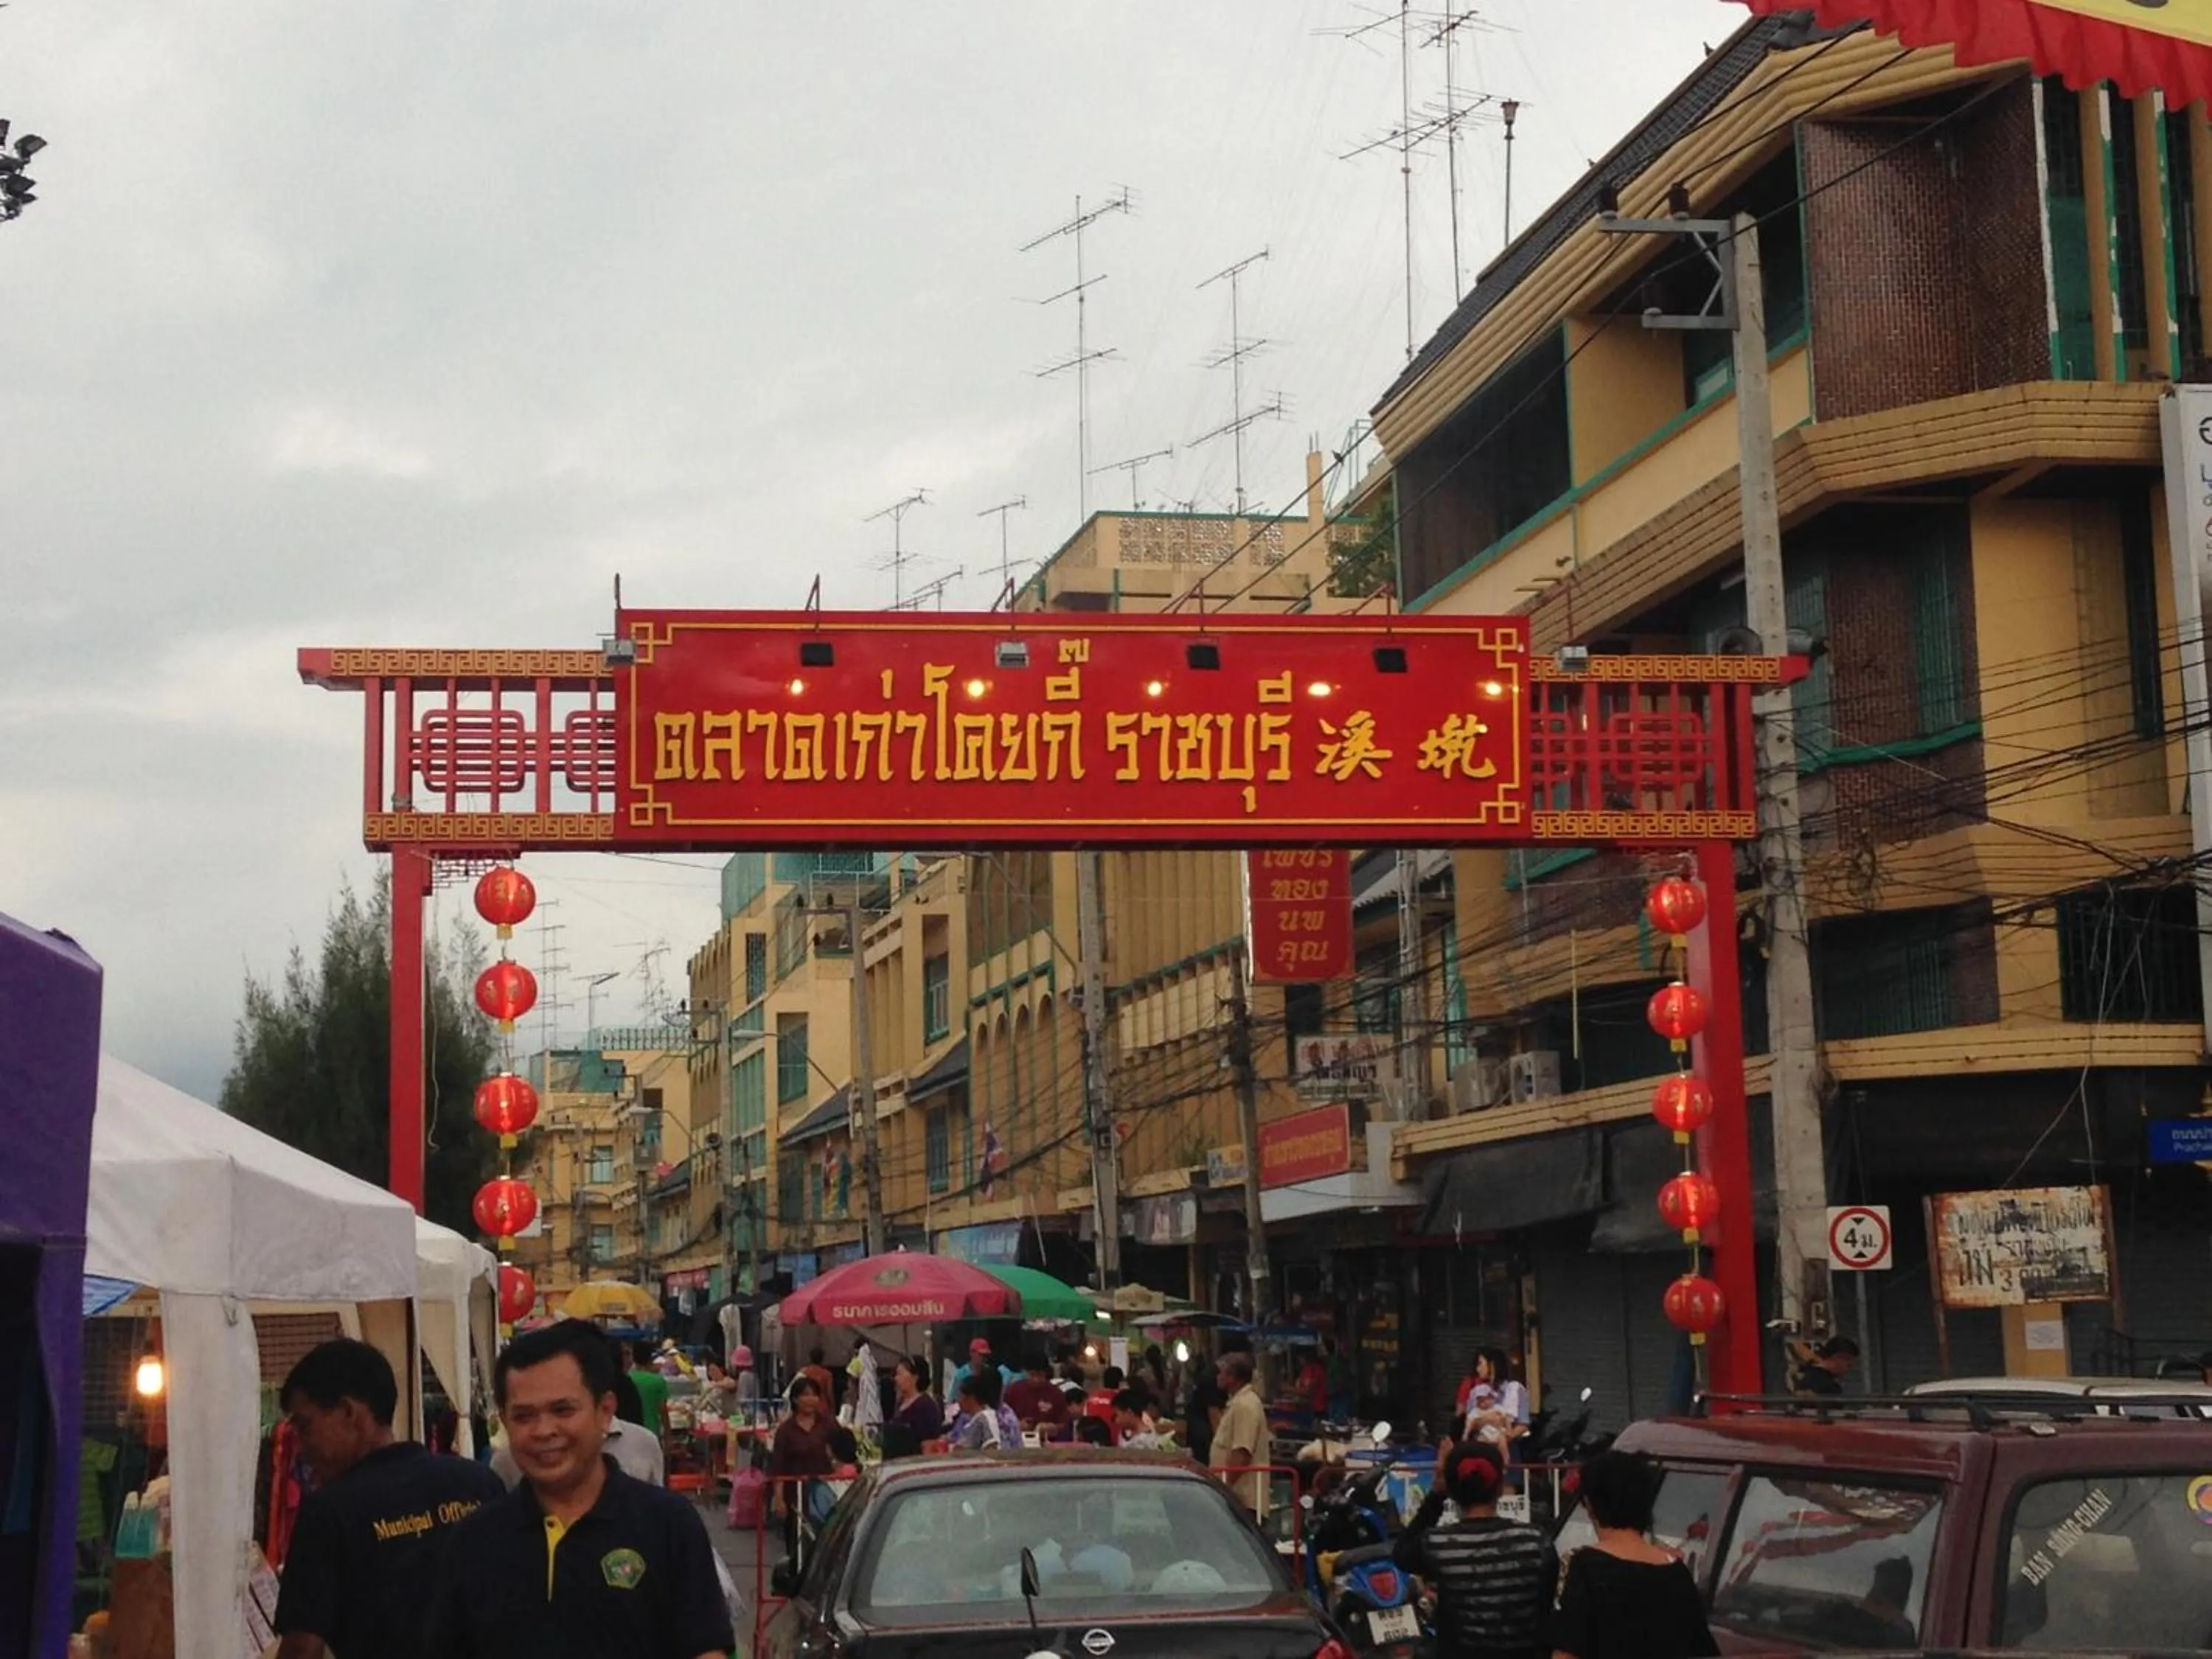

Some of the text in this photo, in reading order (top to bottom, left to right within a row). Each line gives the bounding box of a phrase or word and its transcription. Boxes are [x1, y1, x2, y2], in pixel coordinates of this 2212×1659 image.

[1106, 670, 1292, 812] ราชบุรี
[1843, 1227, 1857, 1248] 4
[372, 1509, 434, 1540] Municipal
